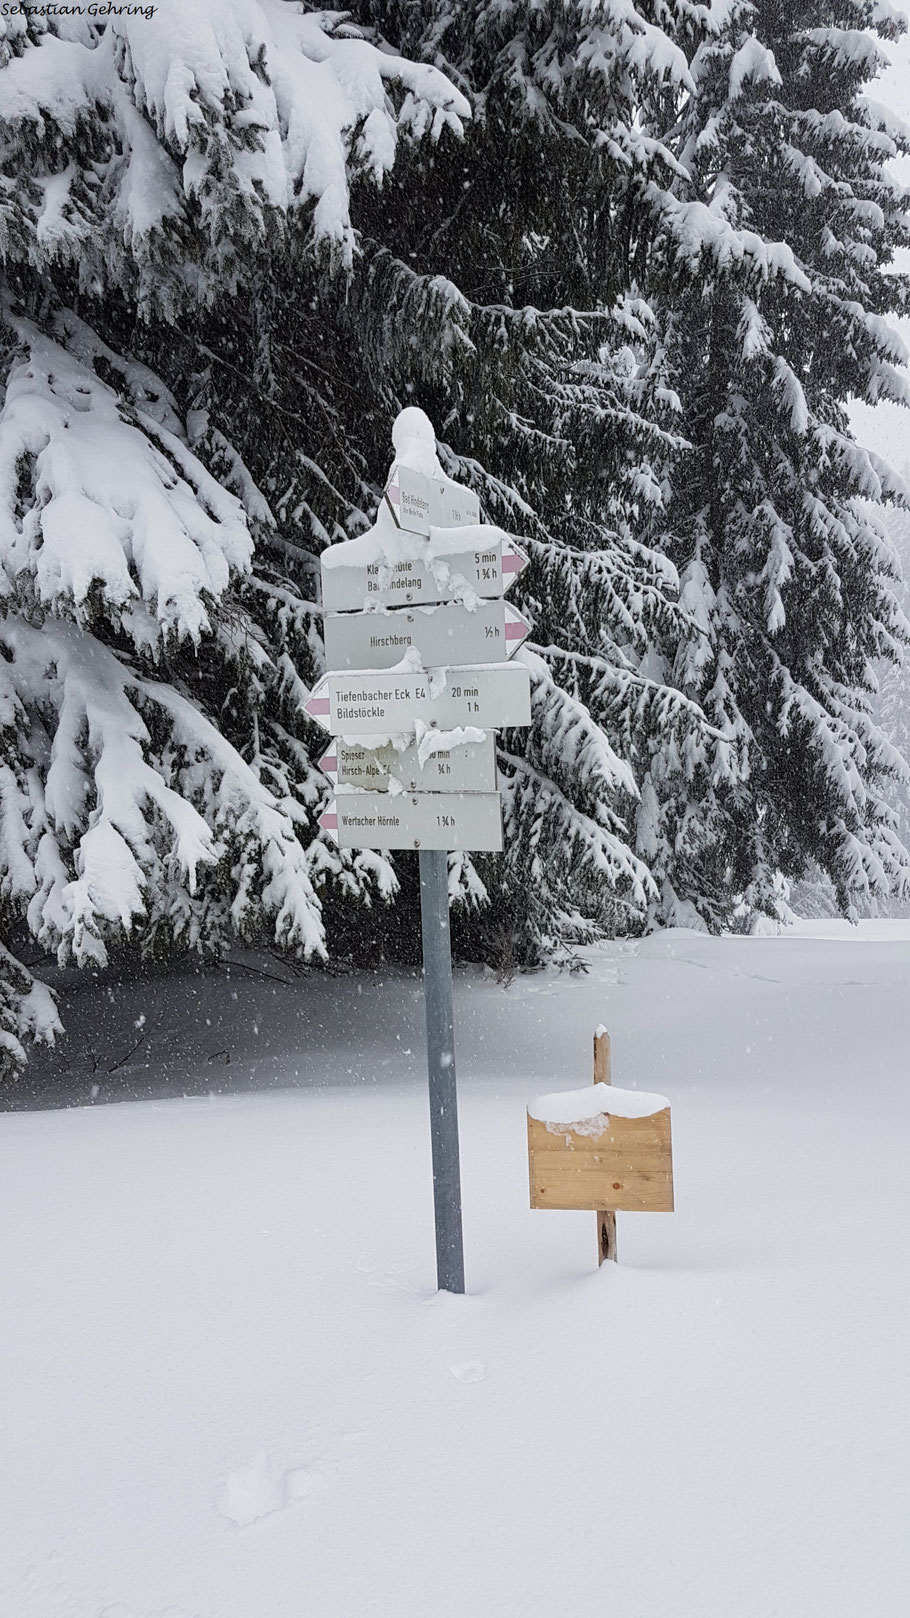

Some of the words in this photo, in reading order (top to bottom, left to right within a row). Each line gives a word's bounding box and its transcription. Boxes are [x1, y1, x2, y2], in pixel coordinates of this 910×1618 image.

[475, 554, 480, 563] 5
[482, 552, 496, 563] min
[477, 570, 480, 579] 1
[492, 569, 497, 578] h
[494, 629, 499, 637] h
[370, 635, 411, 647] Hirschberg
[336, 691, 392, 701] Tiefenbacher
[395, 689, 410, 700] Eck
[416, 688, 425, 699] E4
[452, 688, 461, 697] 20
[464, 687, 478, 697] min
[468, 702, 471, 712] 1
[474, 702, 479, 711] h
[337, 707, 385, 719] Bildstöckle
[438, 750, 450, 759] min
[446, 765, 450, 774] h
[342, 816, 376, 826] Wertacher
[378, 815, 399, 826] Hörnle
[450, 817, 455, 826] h
